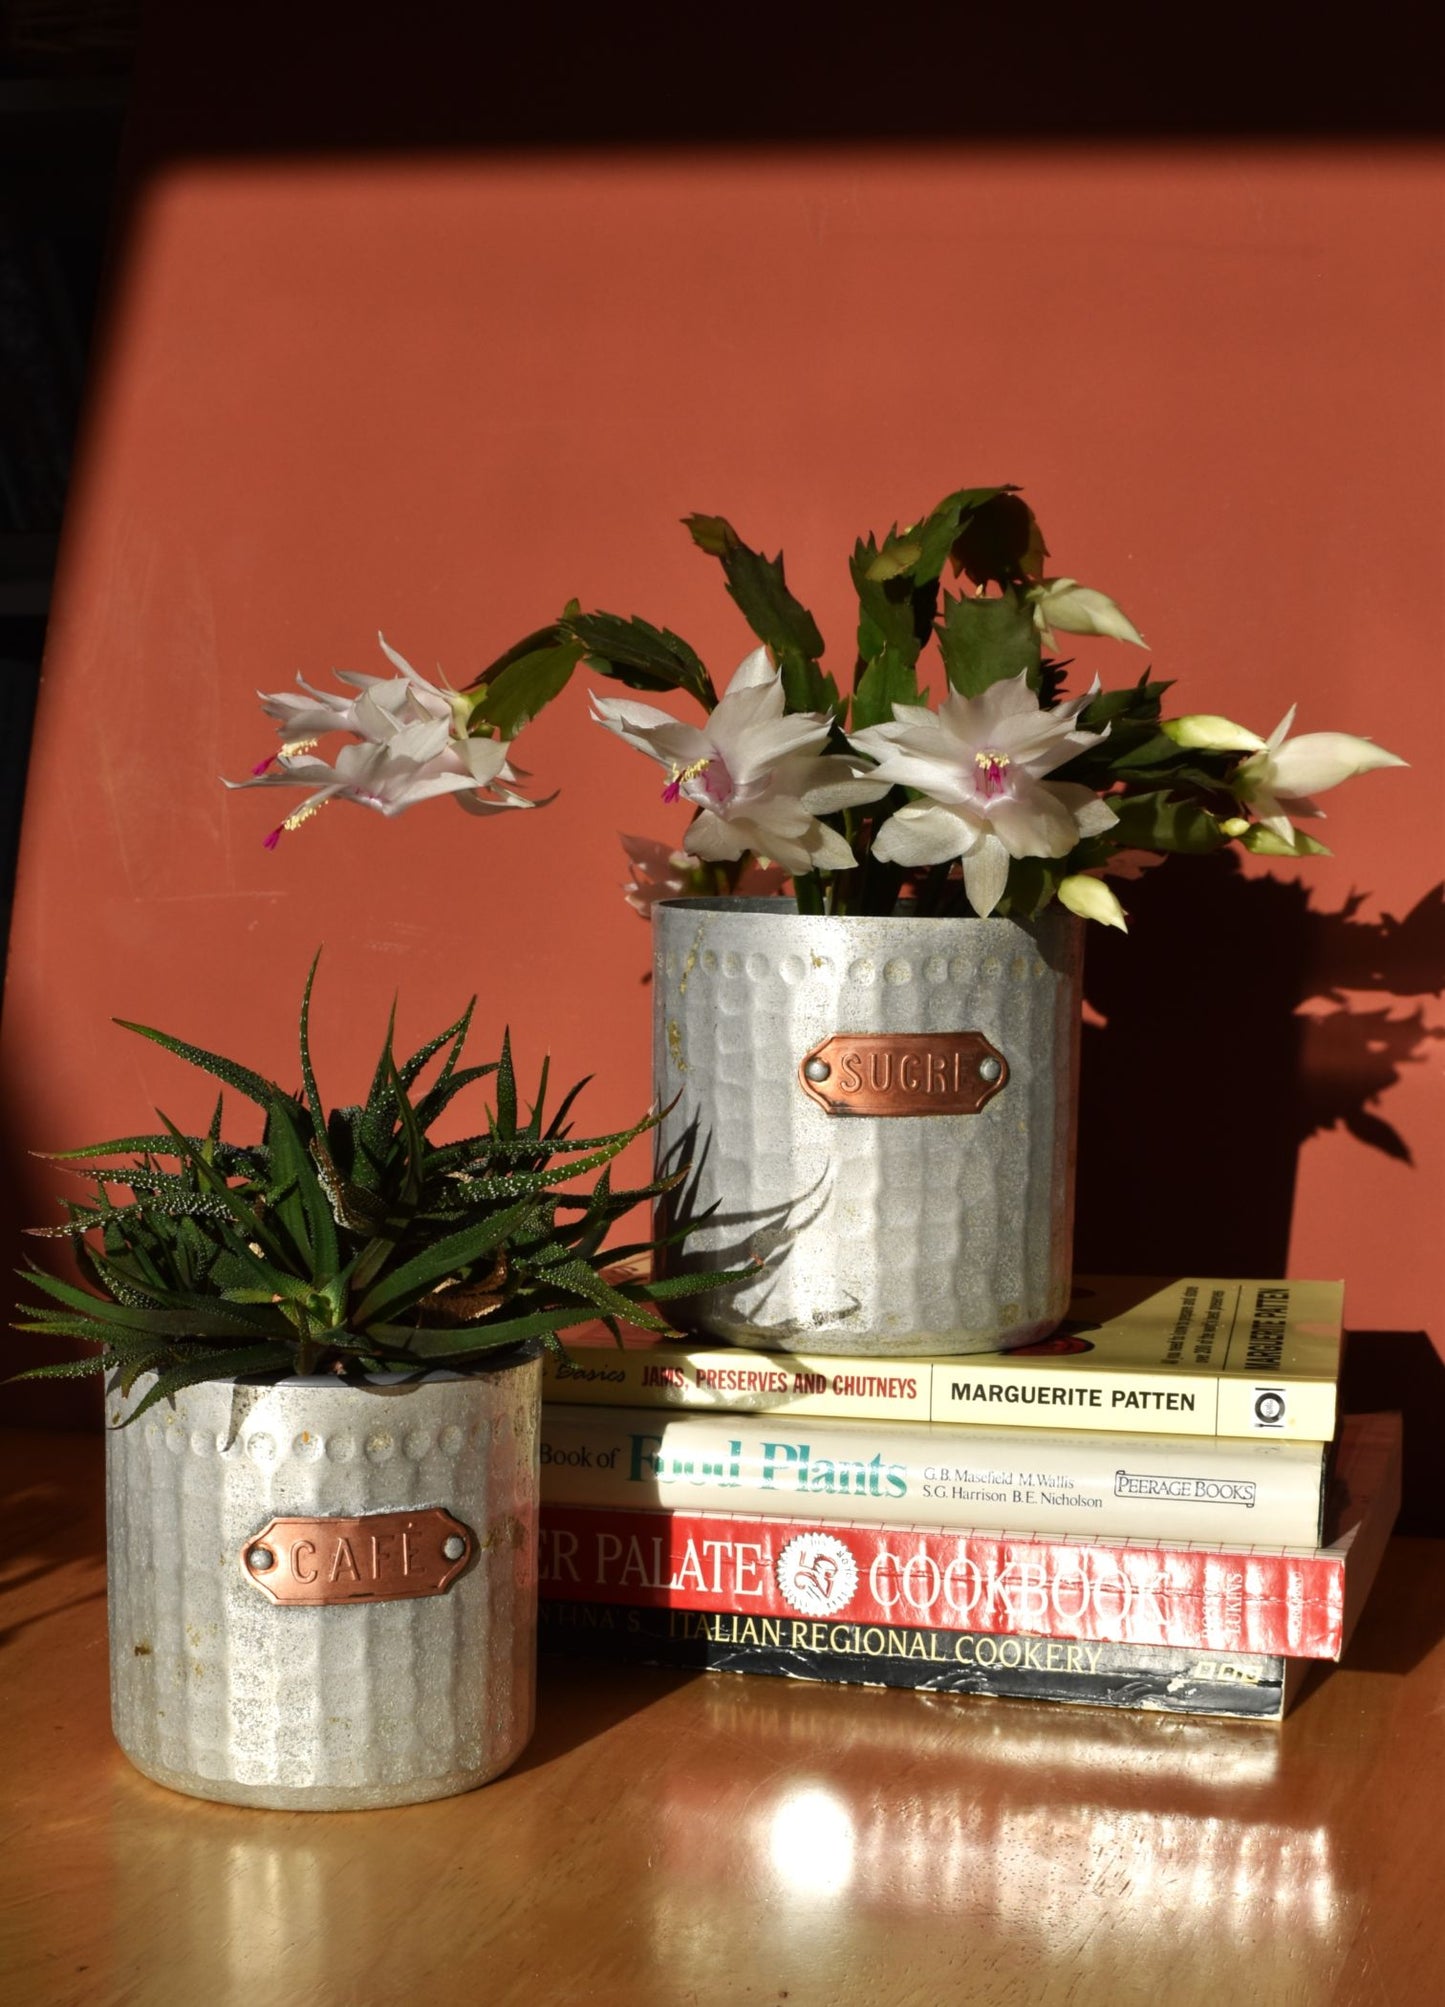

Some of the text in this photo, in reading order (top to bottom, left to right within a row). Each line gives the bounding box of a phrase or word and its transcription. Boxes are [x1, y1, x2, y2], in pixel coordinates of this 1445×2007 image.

[1254, 1288, 1290, 1318] PATTEN
[1244, 1320, 1286, 1370] MARGUERITE
[641, 1365, 918, 1400] JAMS, PRESERVES AND CHUTNEYS
[951, 1382, 1196, 1412] MARGUERITE PATTEN
[541, 1443, 592, 1467] Book
[596, 1448, 621, 1469] of
[761, 1442, 908, 1499] Plants
[1117, 1475, 1254, 1501] PEERAGE BOOKS
[952, 1485, 1007, 1502] Harrison
[1041, 1491, 1103, 1508] Nicholson
[594, 1532, 763, 1596] PALATE
[869, 1552, 1170, 1625] COOKBOOK
[1224, 1573, 1243, 1635] LUKINS
[669, 1611, 781, 1646] ITALIAN
[792, 1622, 948, 1663] REGIONAL
[955, 1634, 1103, 1675] COOKERY
